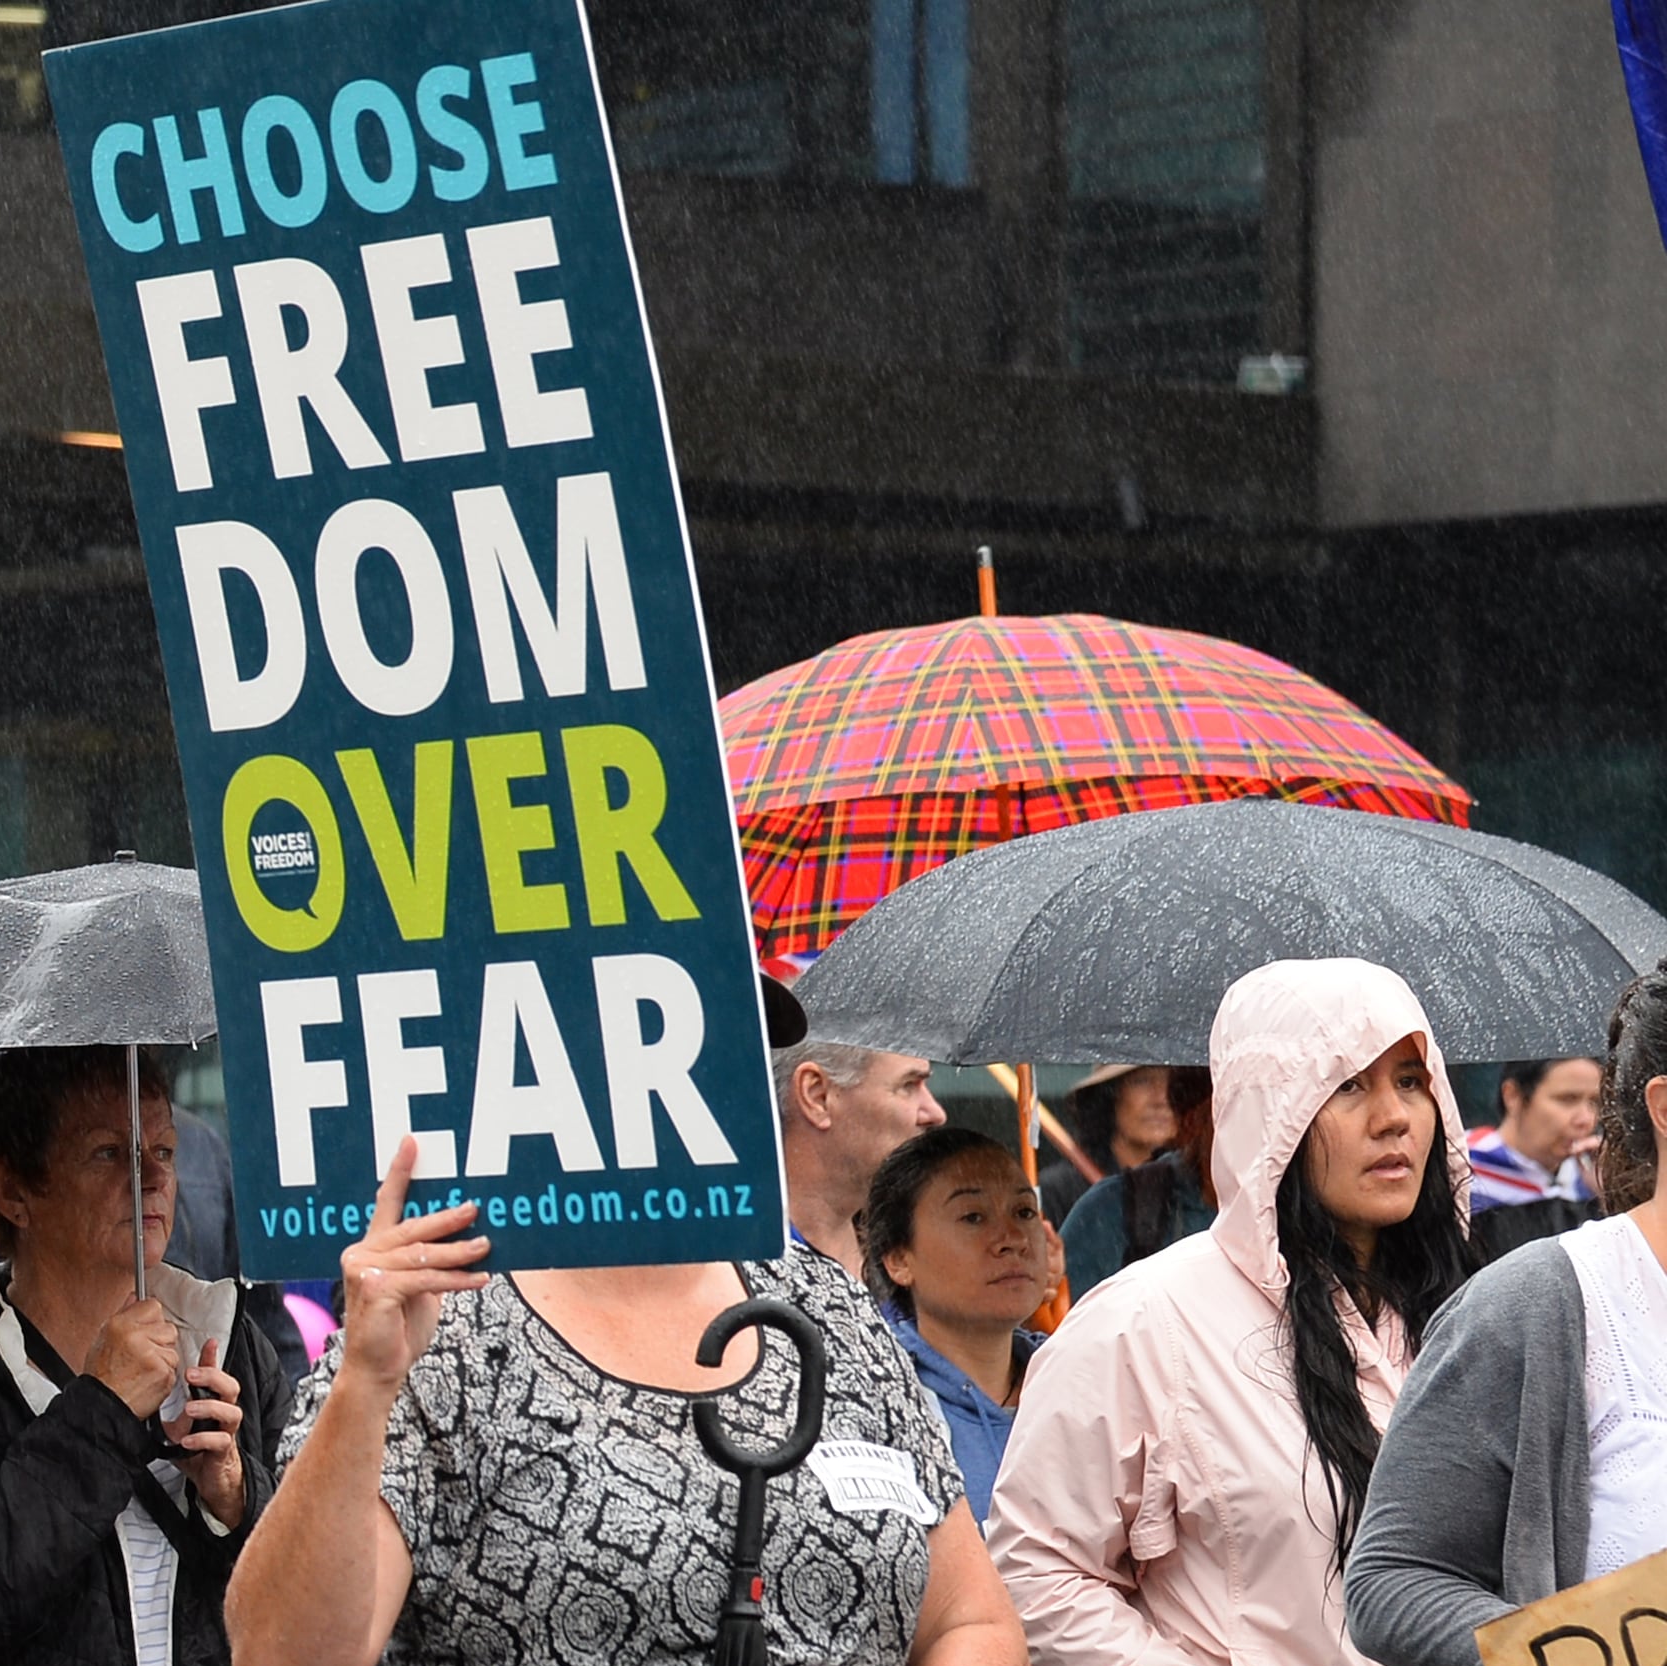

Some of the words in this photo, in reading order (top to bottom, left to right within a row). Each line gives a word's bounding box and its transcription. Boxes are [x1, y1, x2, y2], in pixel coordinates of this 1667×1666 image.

[88, 51, 558, 254] CHOOSE
[135, 215, 594, 493] FREE
[174, 470, 648, 734] DOM
[221, 723, 703, 953] OVER
[250, 832, 307, 854] VOICES
[253, 850, 316, 871] FREEDOM
[258, 952, 739, 1187] FEAR
[259, 1183, 756, 1238] voiceorfeedom.co.nz
